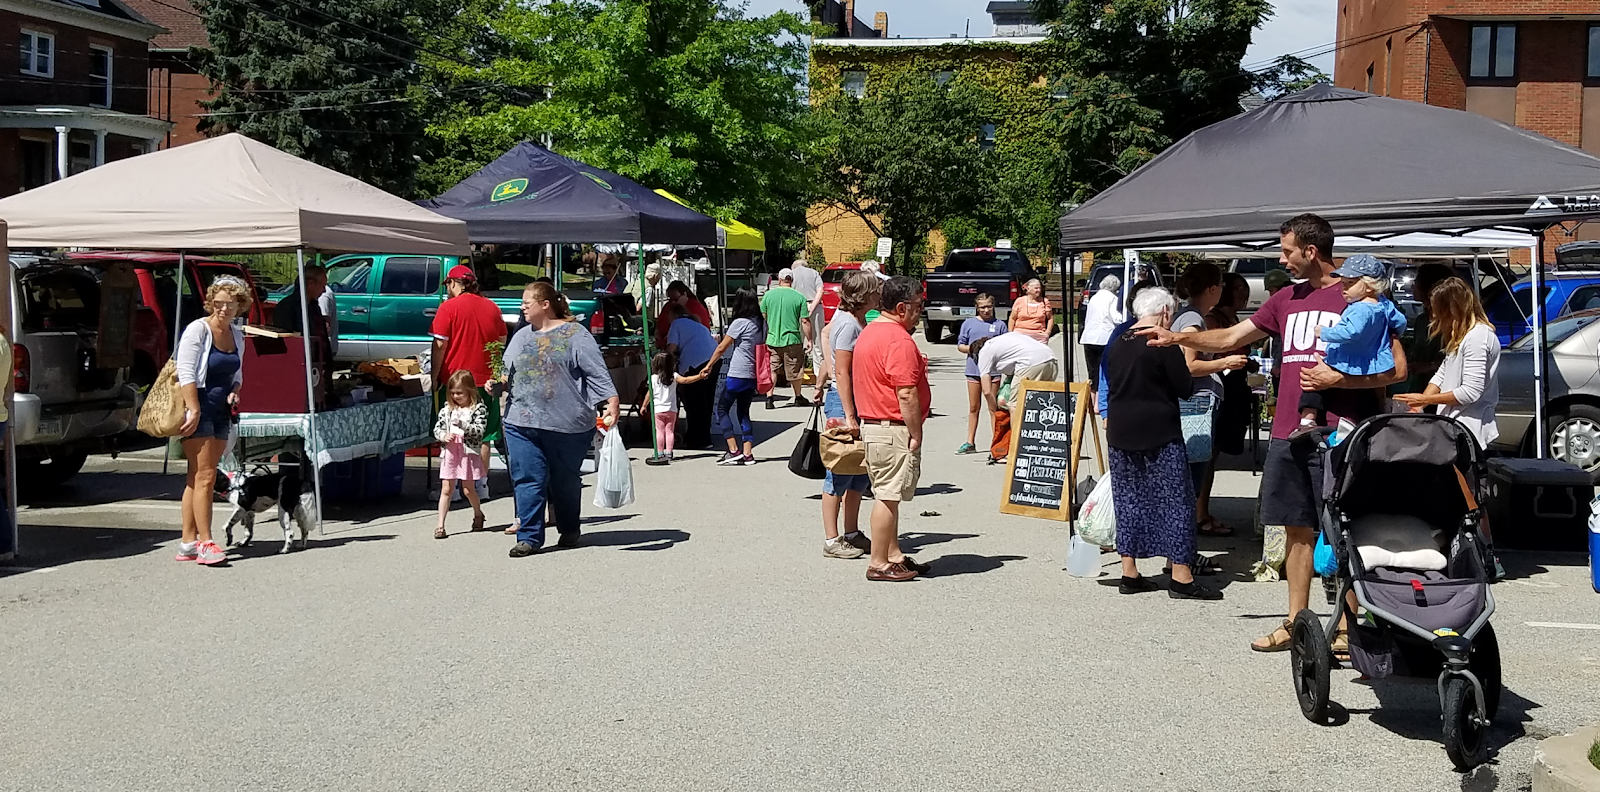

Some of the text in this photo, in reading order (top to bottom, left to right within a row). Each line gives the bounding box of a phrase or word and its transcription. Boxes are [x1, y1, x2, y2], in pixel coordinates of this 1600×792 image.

[1283, 310, 1342, 352] IUP
[1025, 410, 1039, 422] FAT
[1028, 429, 1042, 439] ACRE
